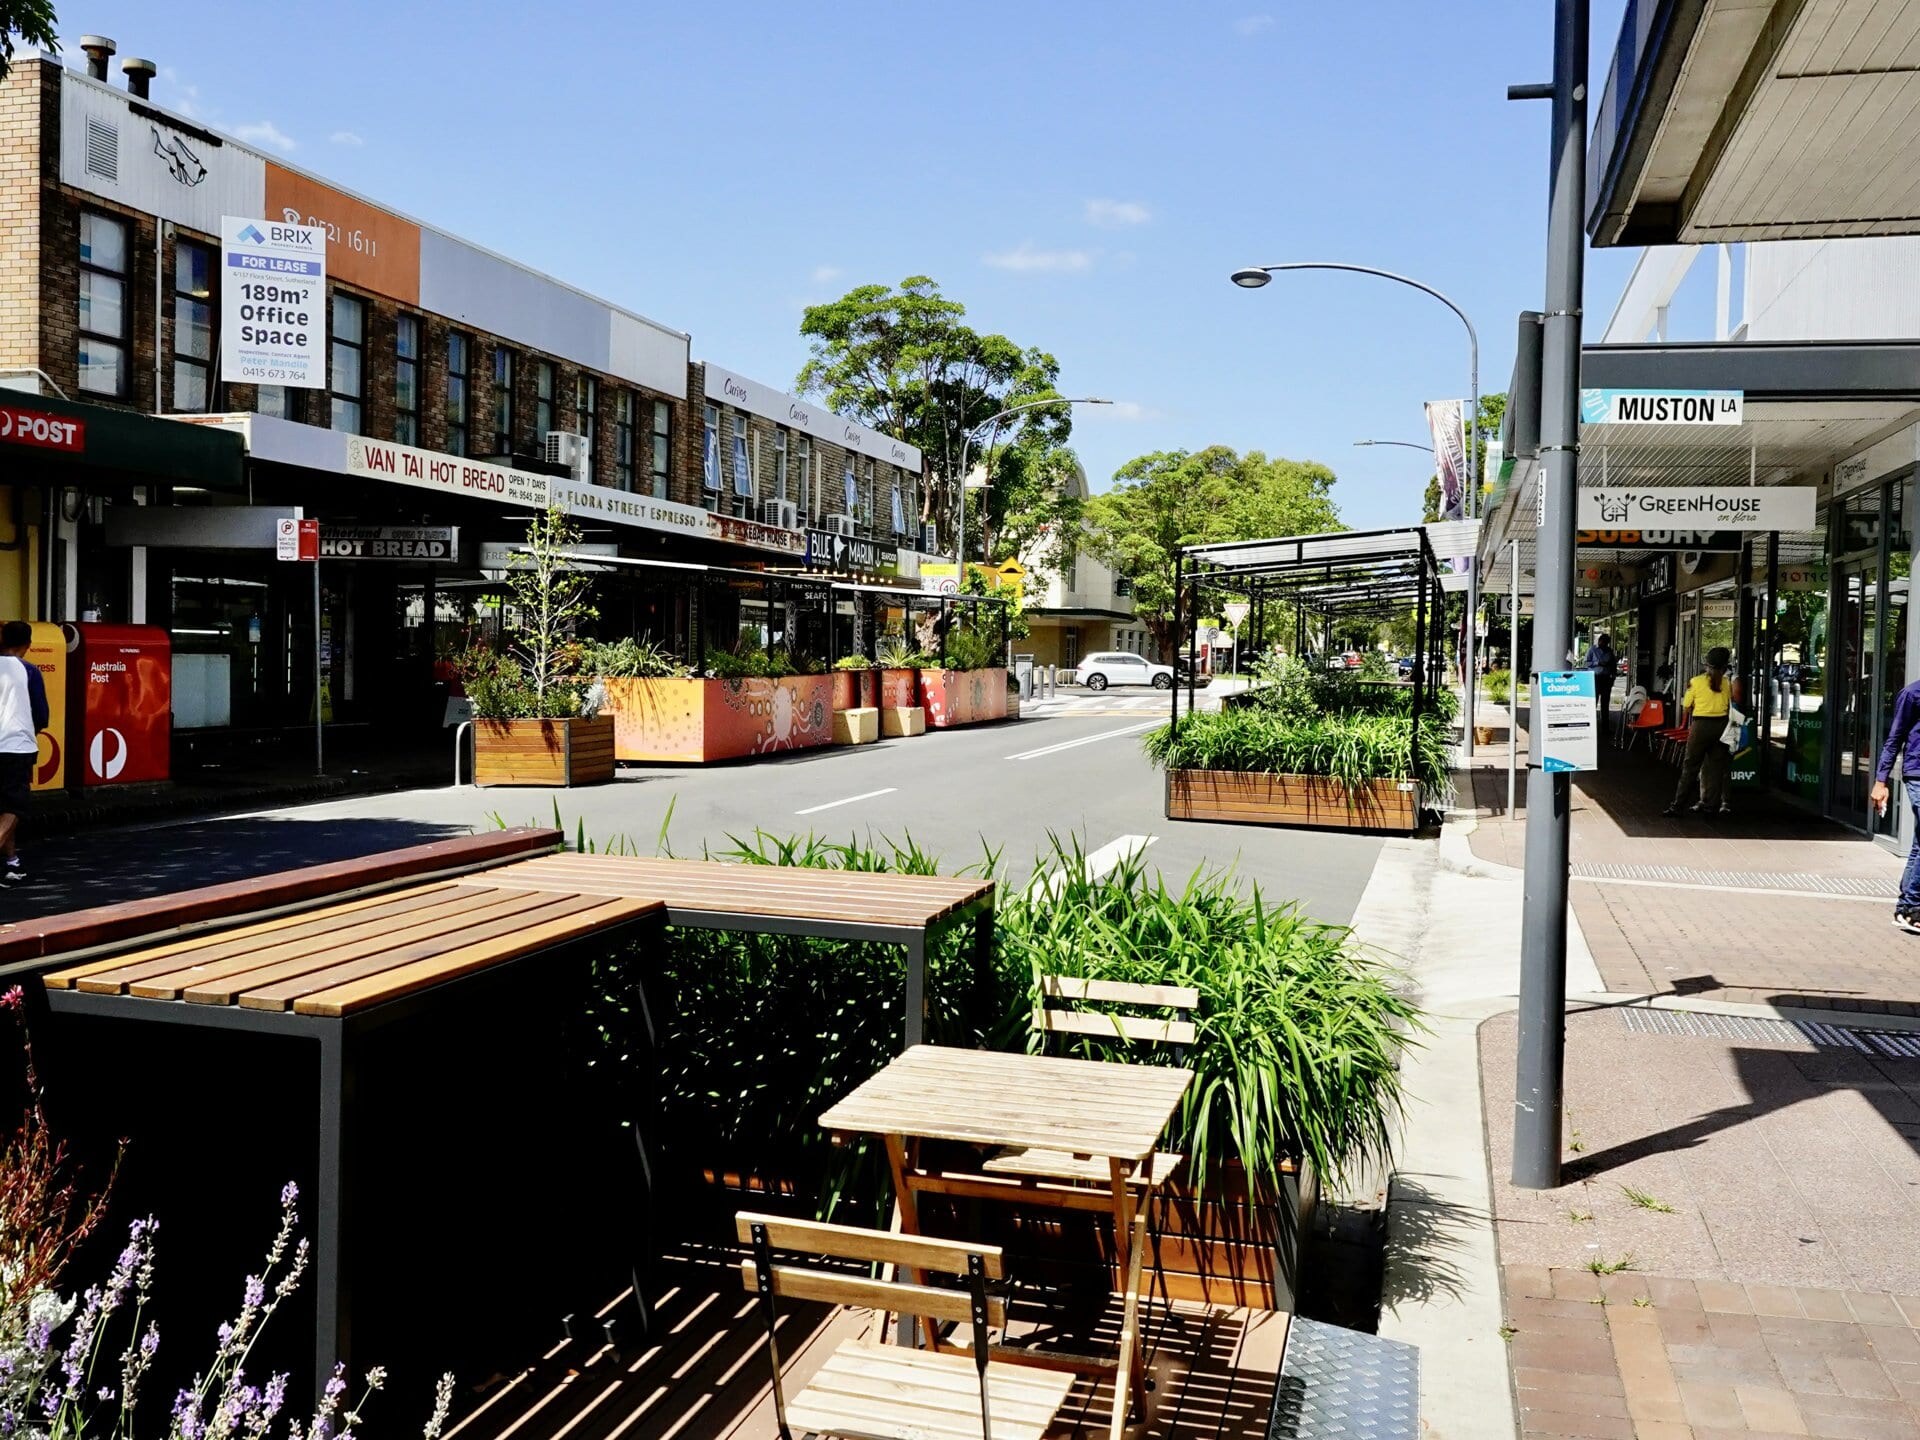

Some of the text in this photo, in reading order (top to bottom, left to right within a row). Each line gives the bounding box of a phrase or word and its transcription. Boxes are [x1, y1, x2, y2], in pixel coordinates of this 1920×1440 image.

[271, 227, 312, 245] BRIX
[348, 230, 376, 257] 1611
[241, 256, 307, 273] FOR LEASE
[240, 304, 309, 326] Office
[241, 325, 308, 347] Space
[242, 366, 306, 380] 0415 673 764
[1618, 397, 1737, 422] MUSTON LA
[18, 415, 77, 445] POST
[365, 445, 505, 494] VAN TAI HOT BREAD
[508, 474, 547, 490] OPEN 7 DAYS
[567, 490, 696, 527] FLORA STREET ESPRESSO
[1717, 512, 1757, 523] on flora
[744, 526, 765, 542] KEBAB
[321, 540, 445, 557] HOT BREAD
[811, 532, 874, 566] BLUE MARLIN
[943, 584, 956, 593] 40
[90, 661, 127, 672] Australia
[90, 673, 110, 683] Post
[1547, 684, 1580, 694] changes
